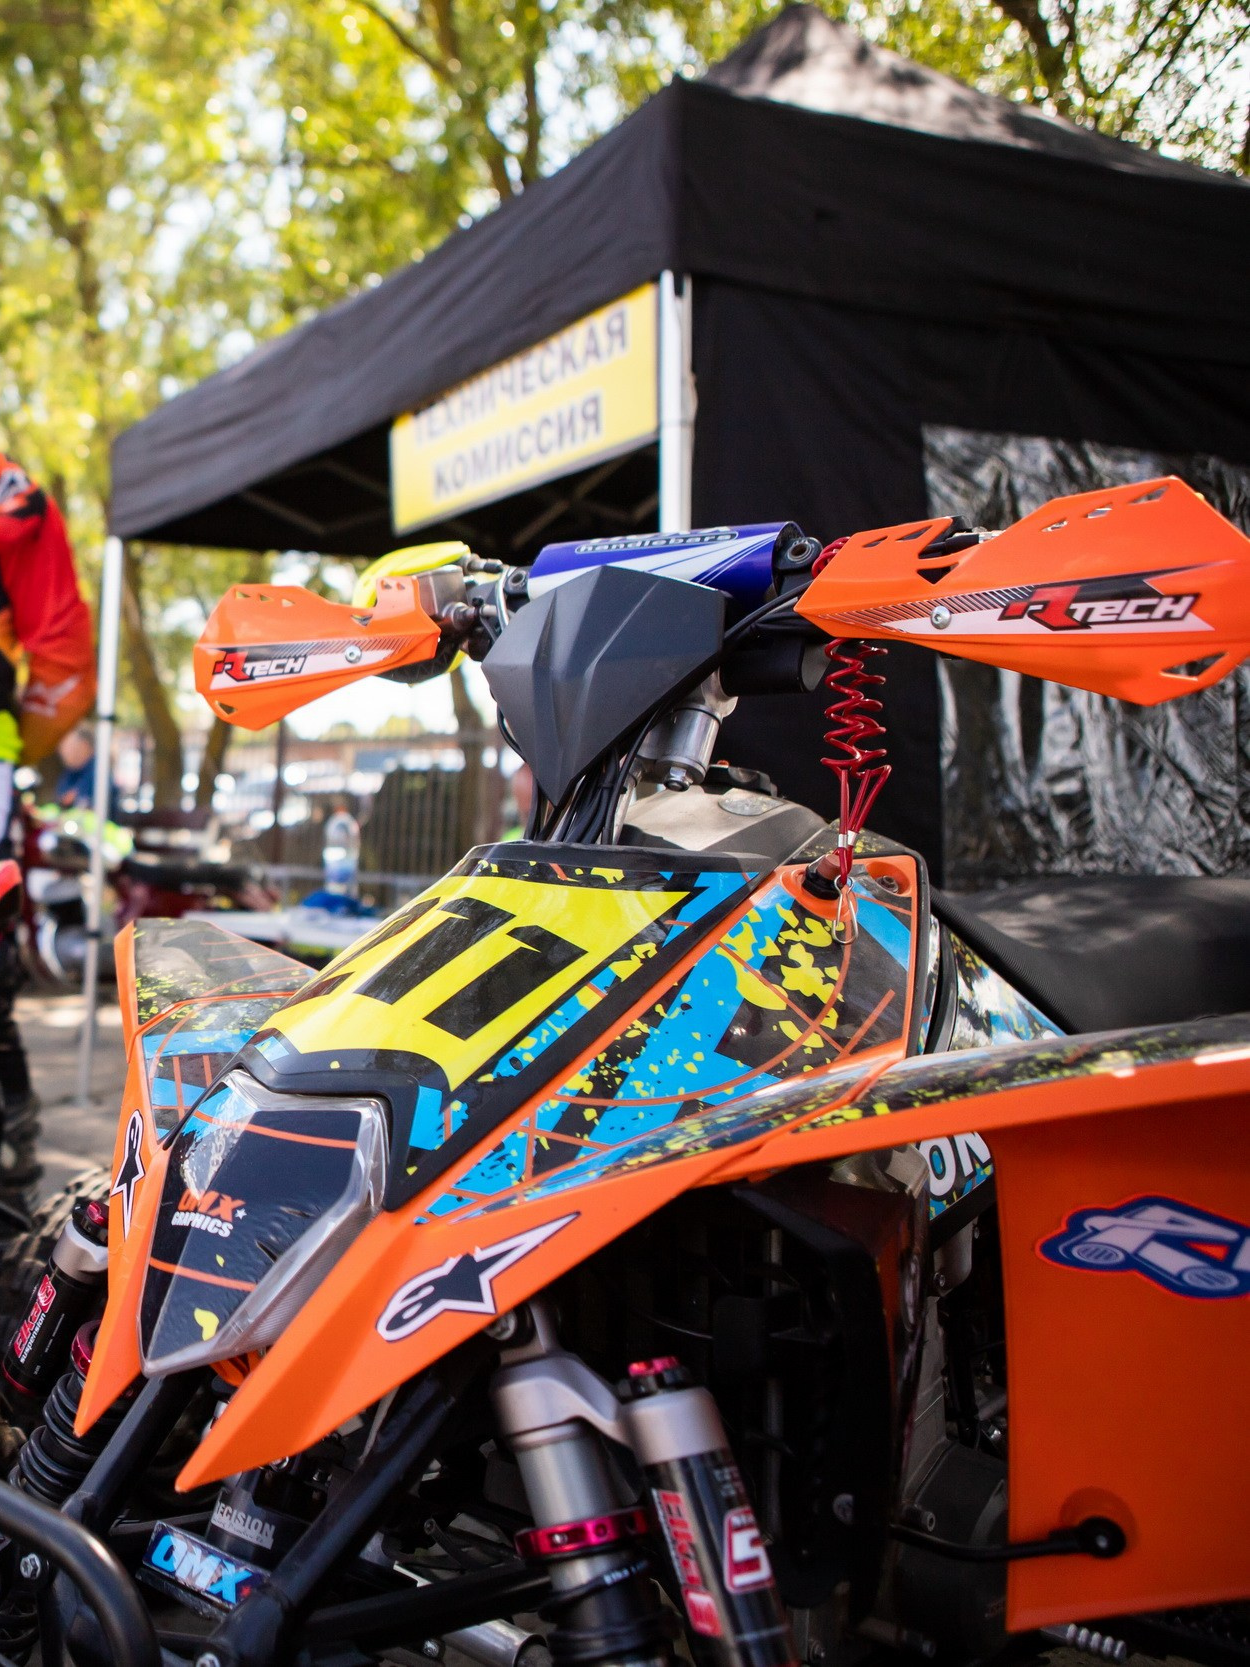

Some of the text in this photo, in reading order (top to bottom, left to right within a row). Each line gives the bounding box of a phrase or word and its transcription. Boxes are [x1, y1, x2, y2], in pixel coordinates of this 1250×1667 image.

[434, 394, 601, 498] КОМИССИЯ
[579, 531, 732, 553] handlebars
[171, 1211, 234, 1238] GRAPHICS
[20, 1312, 47, 1364] suspension
[152, 1534, 252, 1604] OMX
